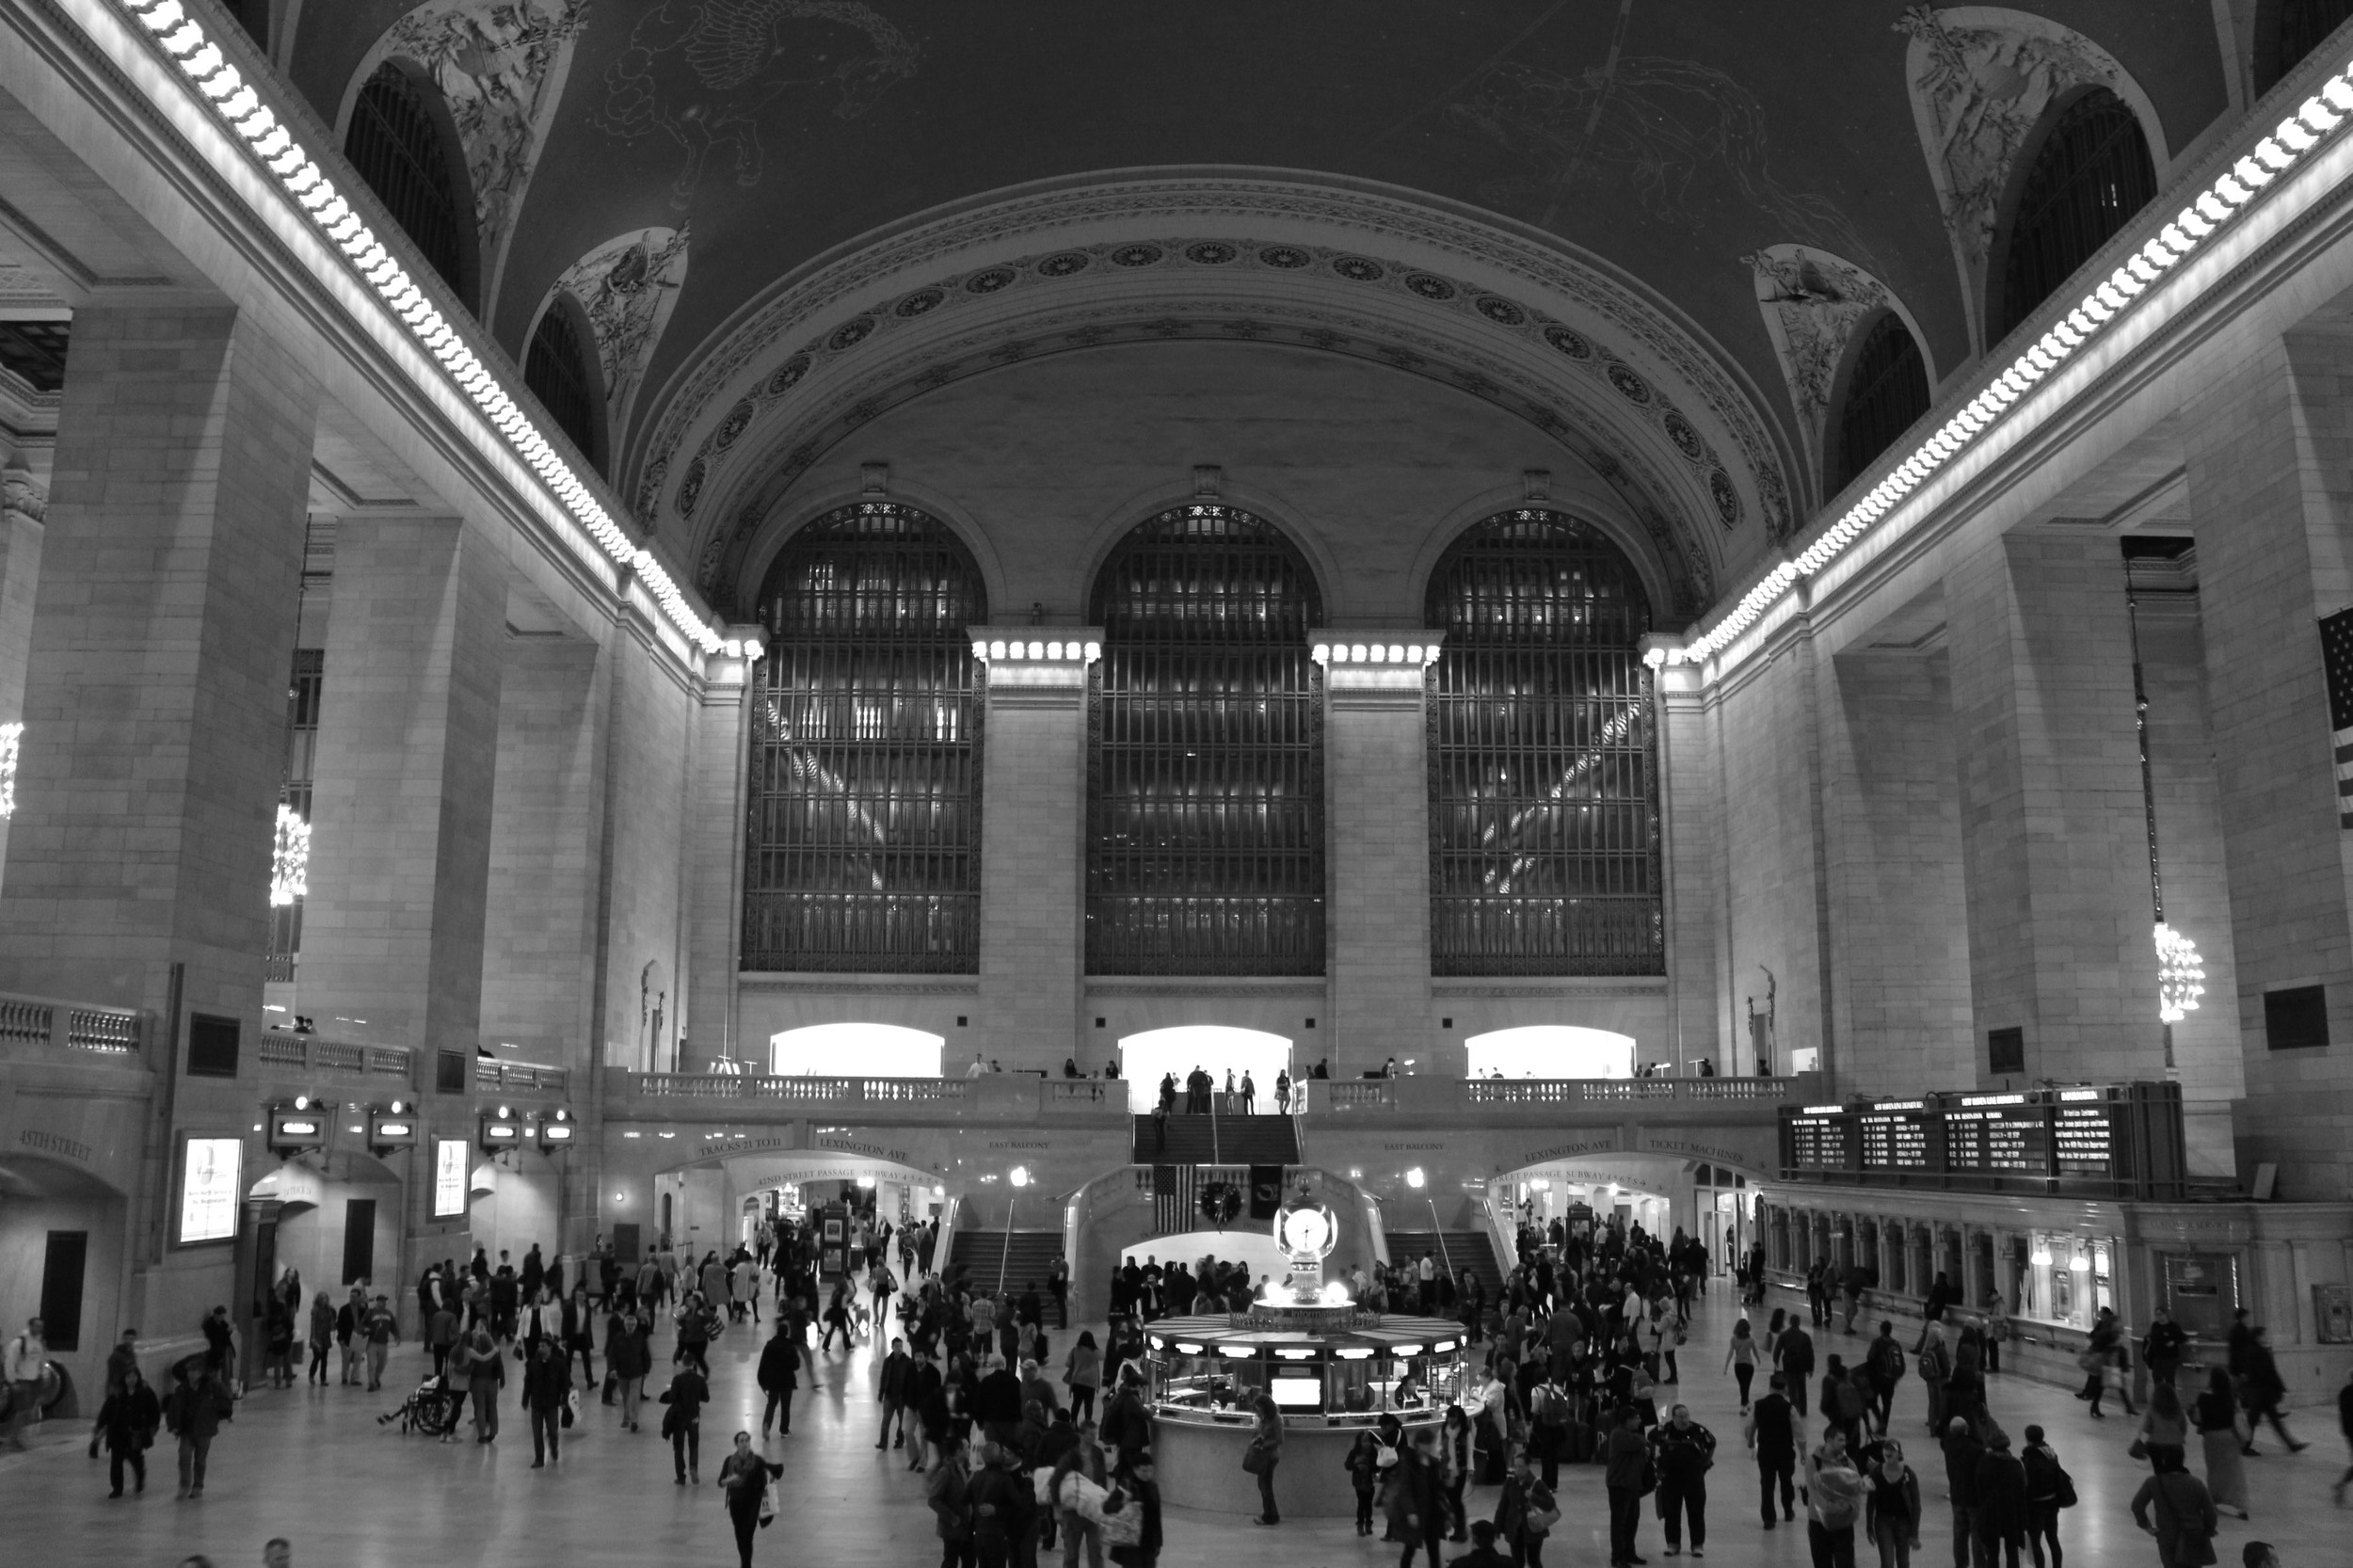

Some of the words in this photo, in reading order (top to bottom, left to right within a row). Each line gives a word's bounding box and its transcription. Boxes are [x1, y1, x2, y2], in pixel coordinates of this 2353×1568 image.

[19, 1129, 49, 1148] 45TH
[51, 1135, 92, 1161] STREET
[699, 1140, 741, 1157] TRACKS
[743, 1140, 753, 1149] 21
[755, 1138, 771, 1147] TO
[820, 1138, 885, 1156] LEXINGTON
[887, 1148, 908, 1161] AVE
[989, 1141, 1008, 1149] EAST
[1010, 1141, 1049, 1149] BALCONY
[1385, 1142, 1404, 1150] EAST
[1406, 1142, 1445, 1150] BALCONY
[1525, 1142, 1589, 1163] LEXINGTON
[1592, 1139, 1612, 1149] AVE
[1649, 1140, 1687, 1151] TICKET
[1689, 1143, 1744, 1161] MACHINES
[759, 1174, 781, 1185] 42ND
[782, 1170, 816, 1182] STREET
[817, 1168, 855, 1177] PASSAGE
[863, 1169, 900, 1180] SUBWAY
[1523, 1170, 1561, 1179] PASSAGE
[1566, 1170, 1604, 1180] SUBWAY
[1291, 1308, 1339, 1319] Information
